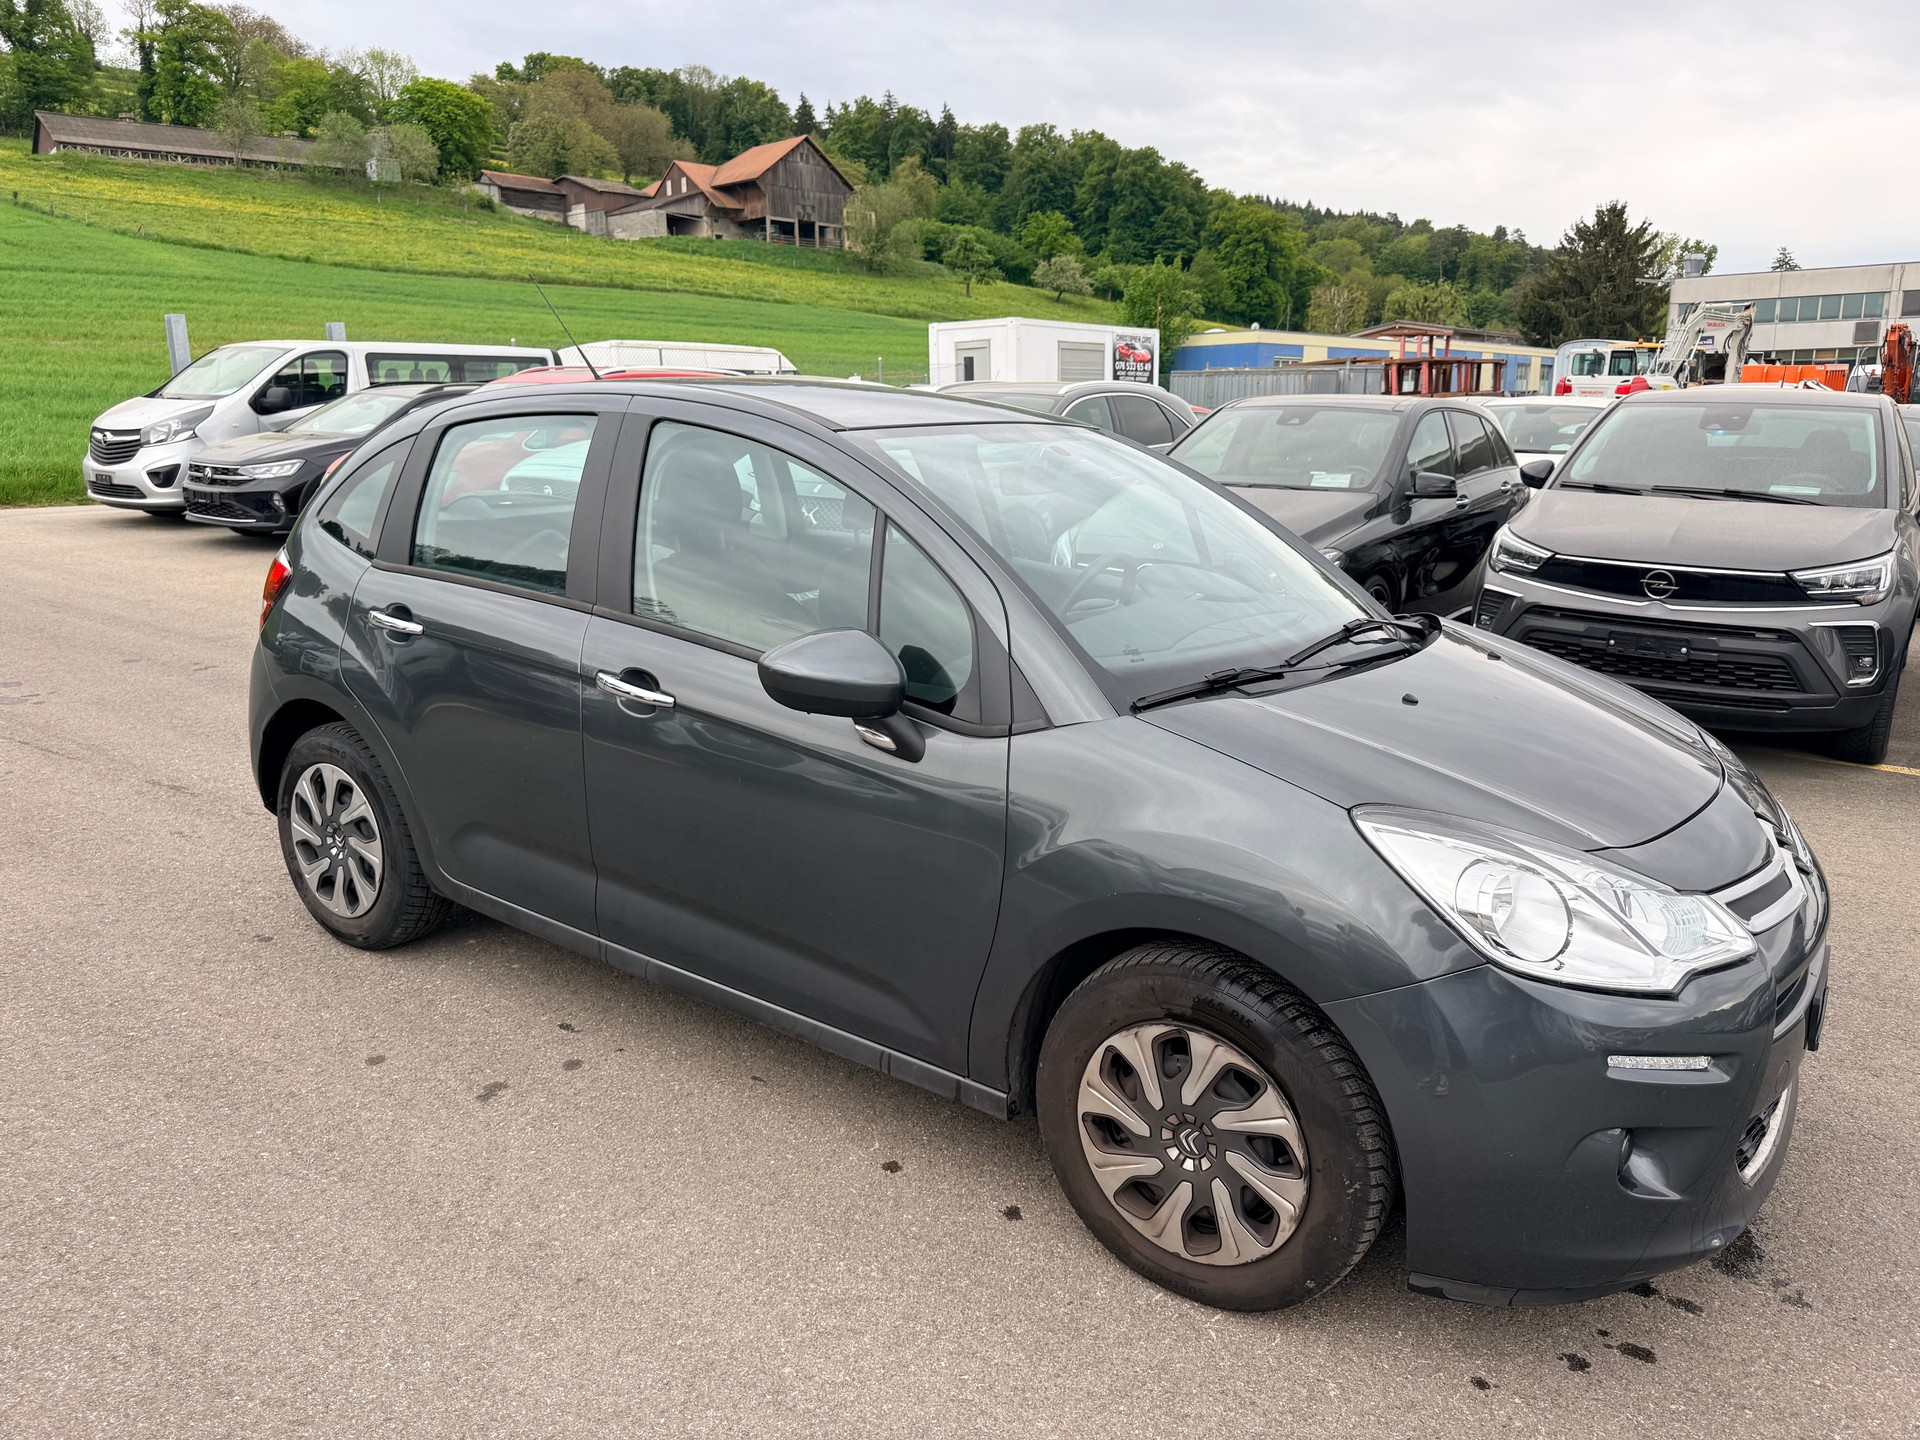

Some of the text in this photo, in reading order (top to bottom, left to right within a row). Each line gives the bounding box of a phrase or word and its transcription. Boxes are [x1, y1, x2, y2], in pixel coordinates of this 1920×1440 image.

[1115, 361, 1152, 371] 076 533 65 49
